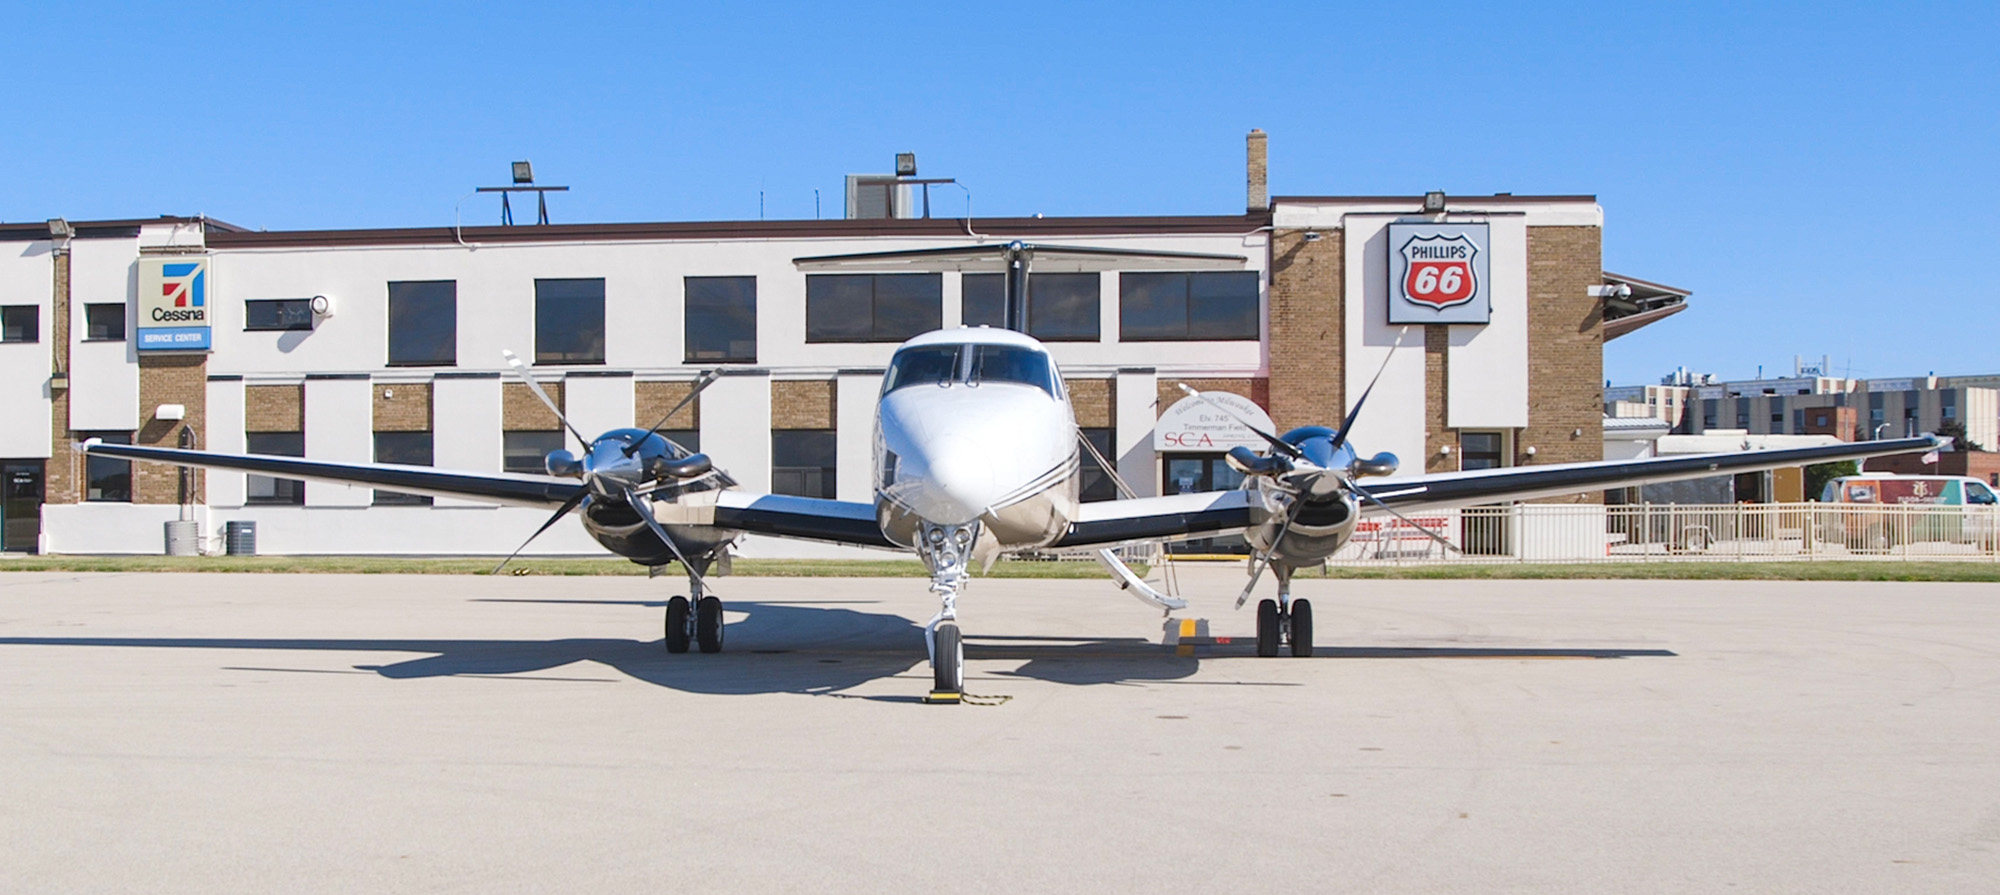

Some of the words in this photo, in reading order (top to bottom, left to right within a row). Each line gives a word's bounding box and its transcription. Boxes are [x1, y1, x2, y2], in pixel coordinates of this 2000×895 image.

[1412, 246, 1466, 259] PHILLIPS
[1415, 265, 1464, 295] 66
[152, 307, 204, 321] Cessna
[144, 334, 173, 343] SERVICE
[175, 333, 202, 342] CENTER
[1184, 423, 1227, 431] Timmerman
[1228, 423, 1247, 431] Field
[1164, 431, 1214, 447] SCA
